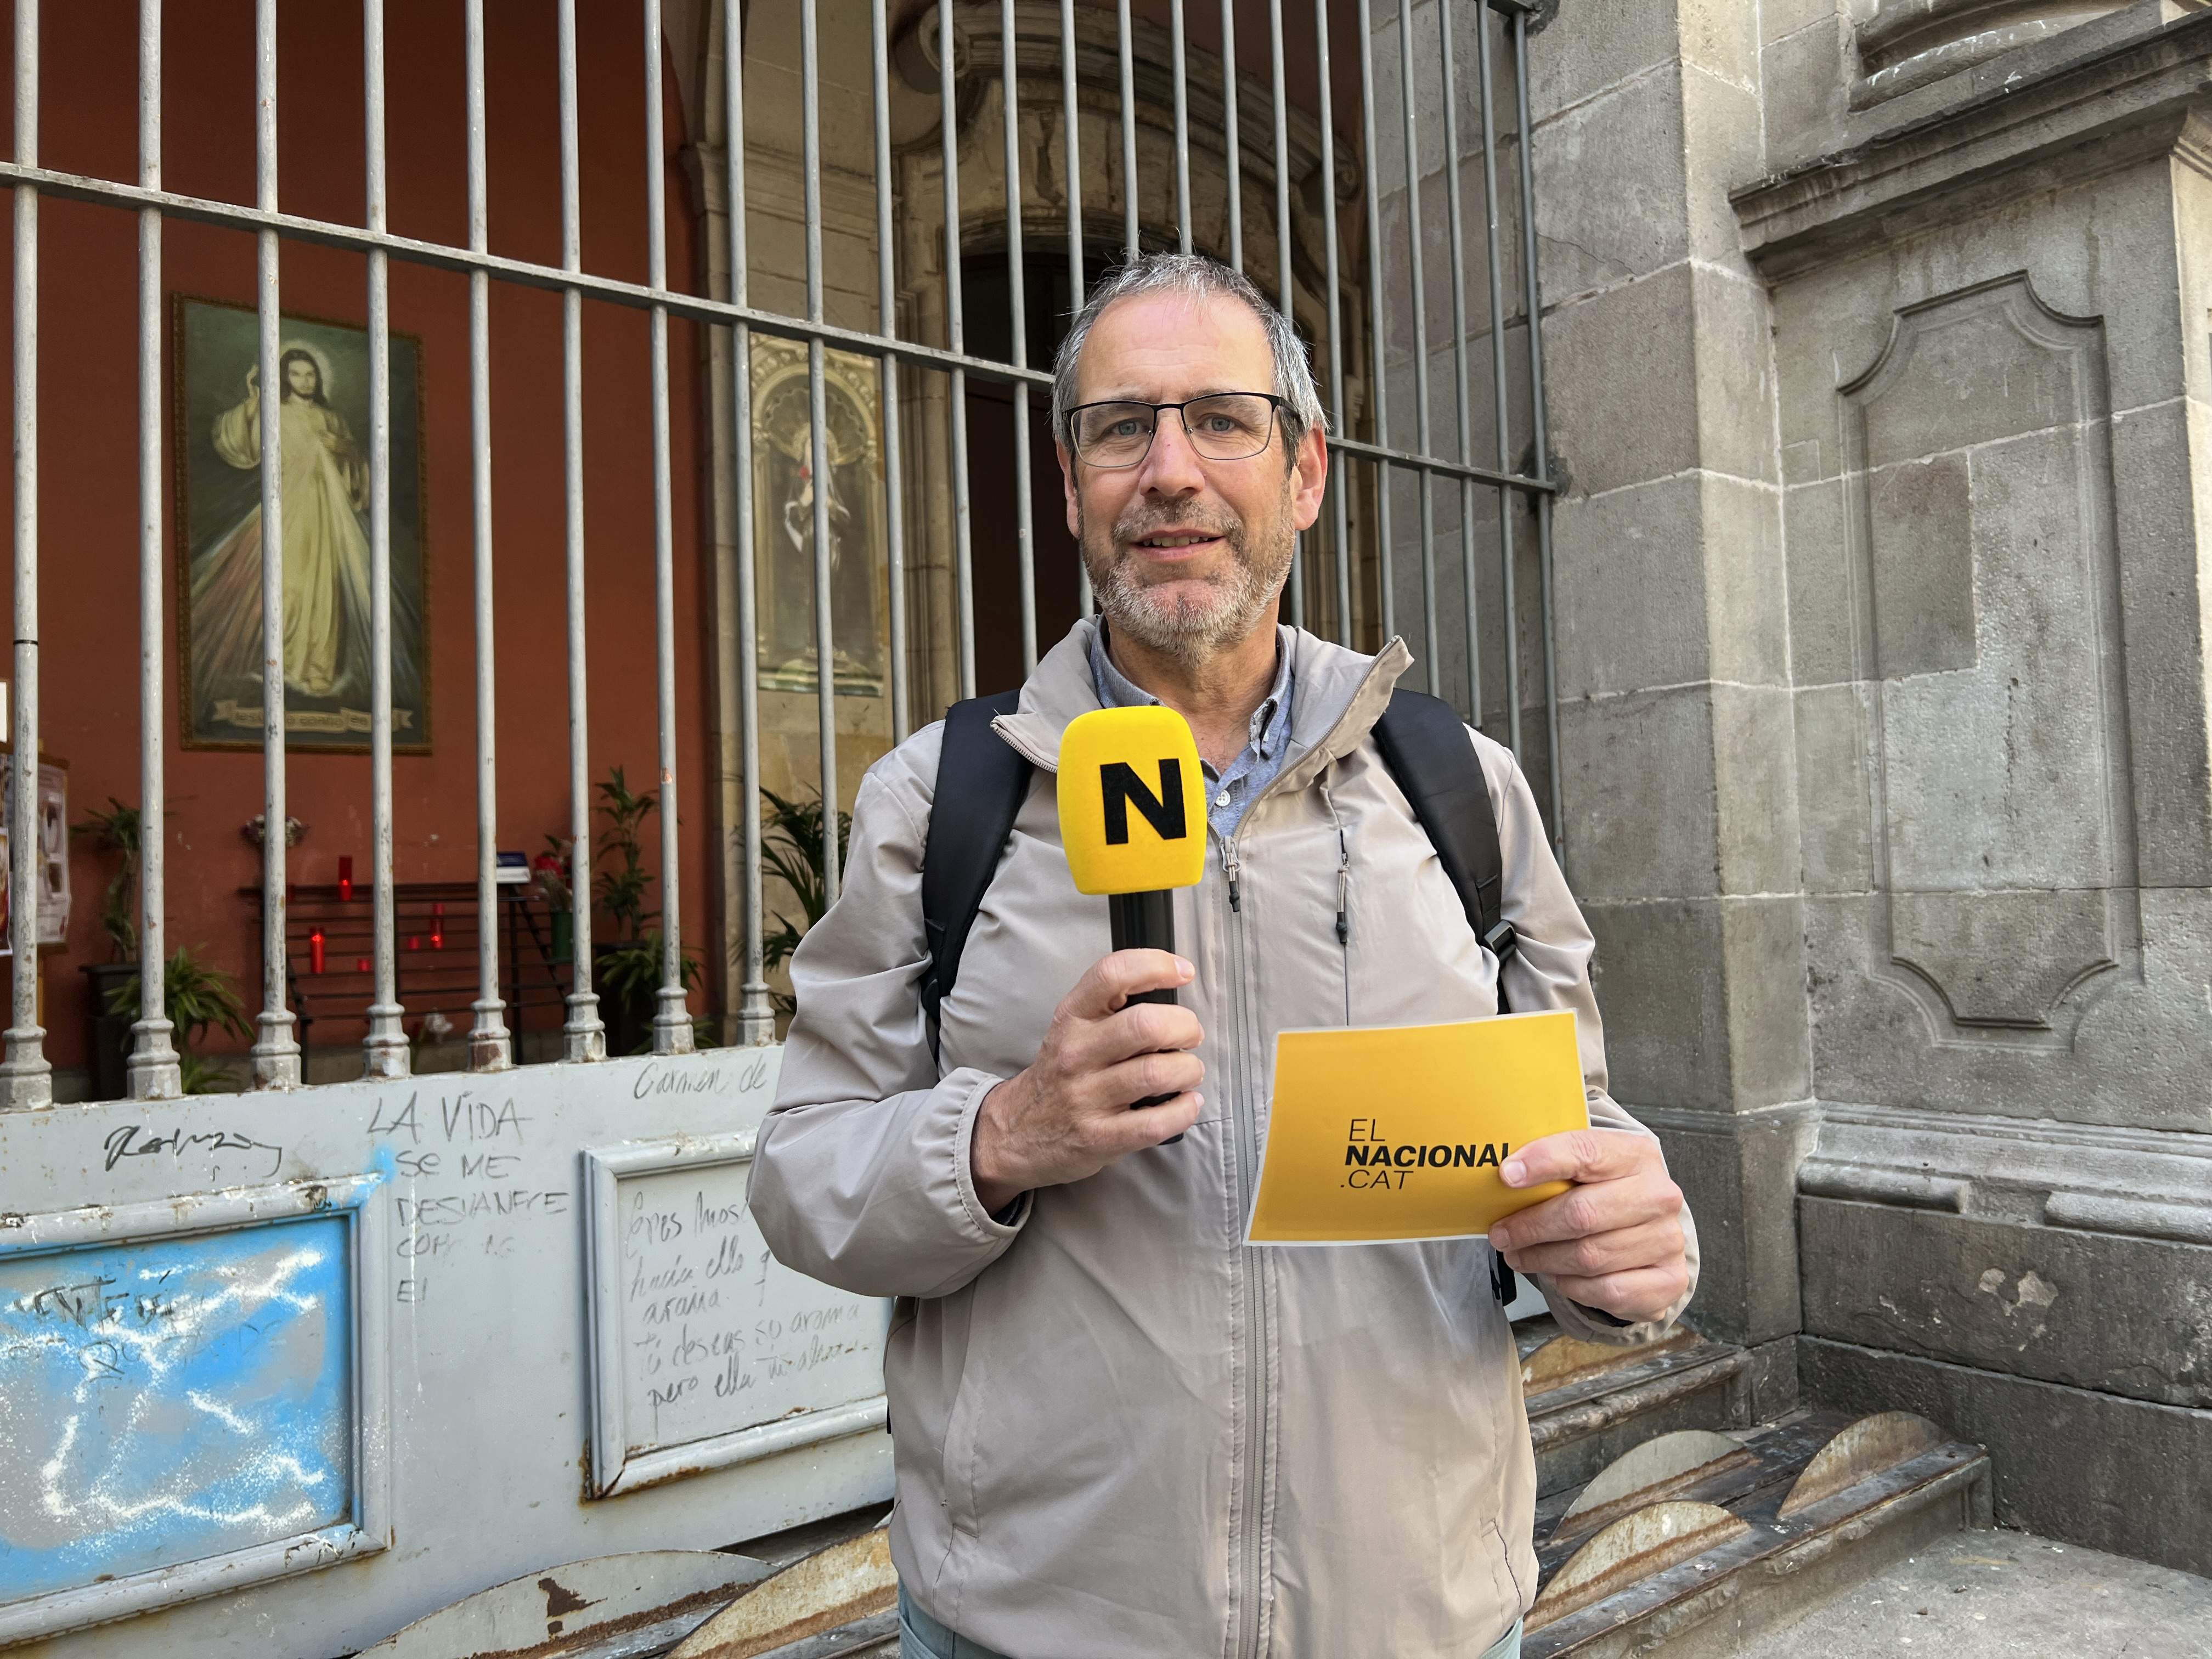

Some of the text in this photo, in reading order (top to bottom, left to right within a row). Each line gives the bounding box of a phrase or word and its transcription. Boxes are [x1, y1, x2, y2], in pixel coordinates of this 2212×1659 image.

[1100, 758, 1186, 845] N
[367, 1091, 424, 1145] LA
[1349, 1119, 1385, 1142] EL
[461, 1153, 521, 1181] ME
[1341, 1169, 1414, 1189] .CAT
